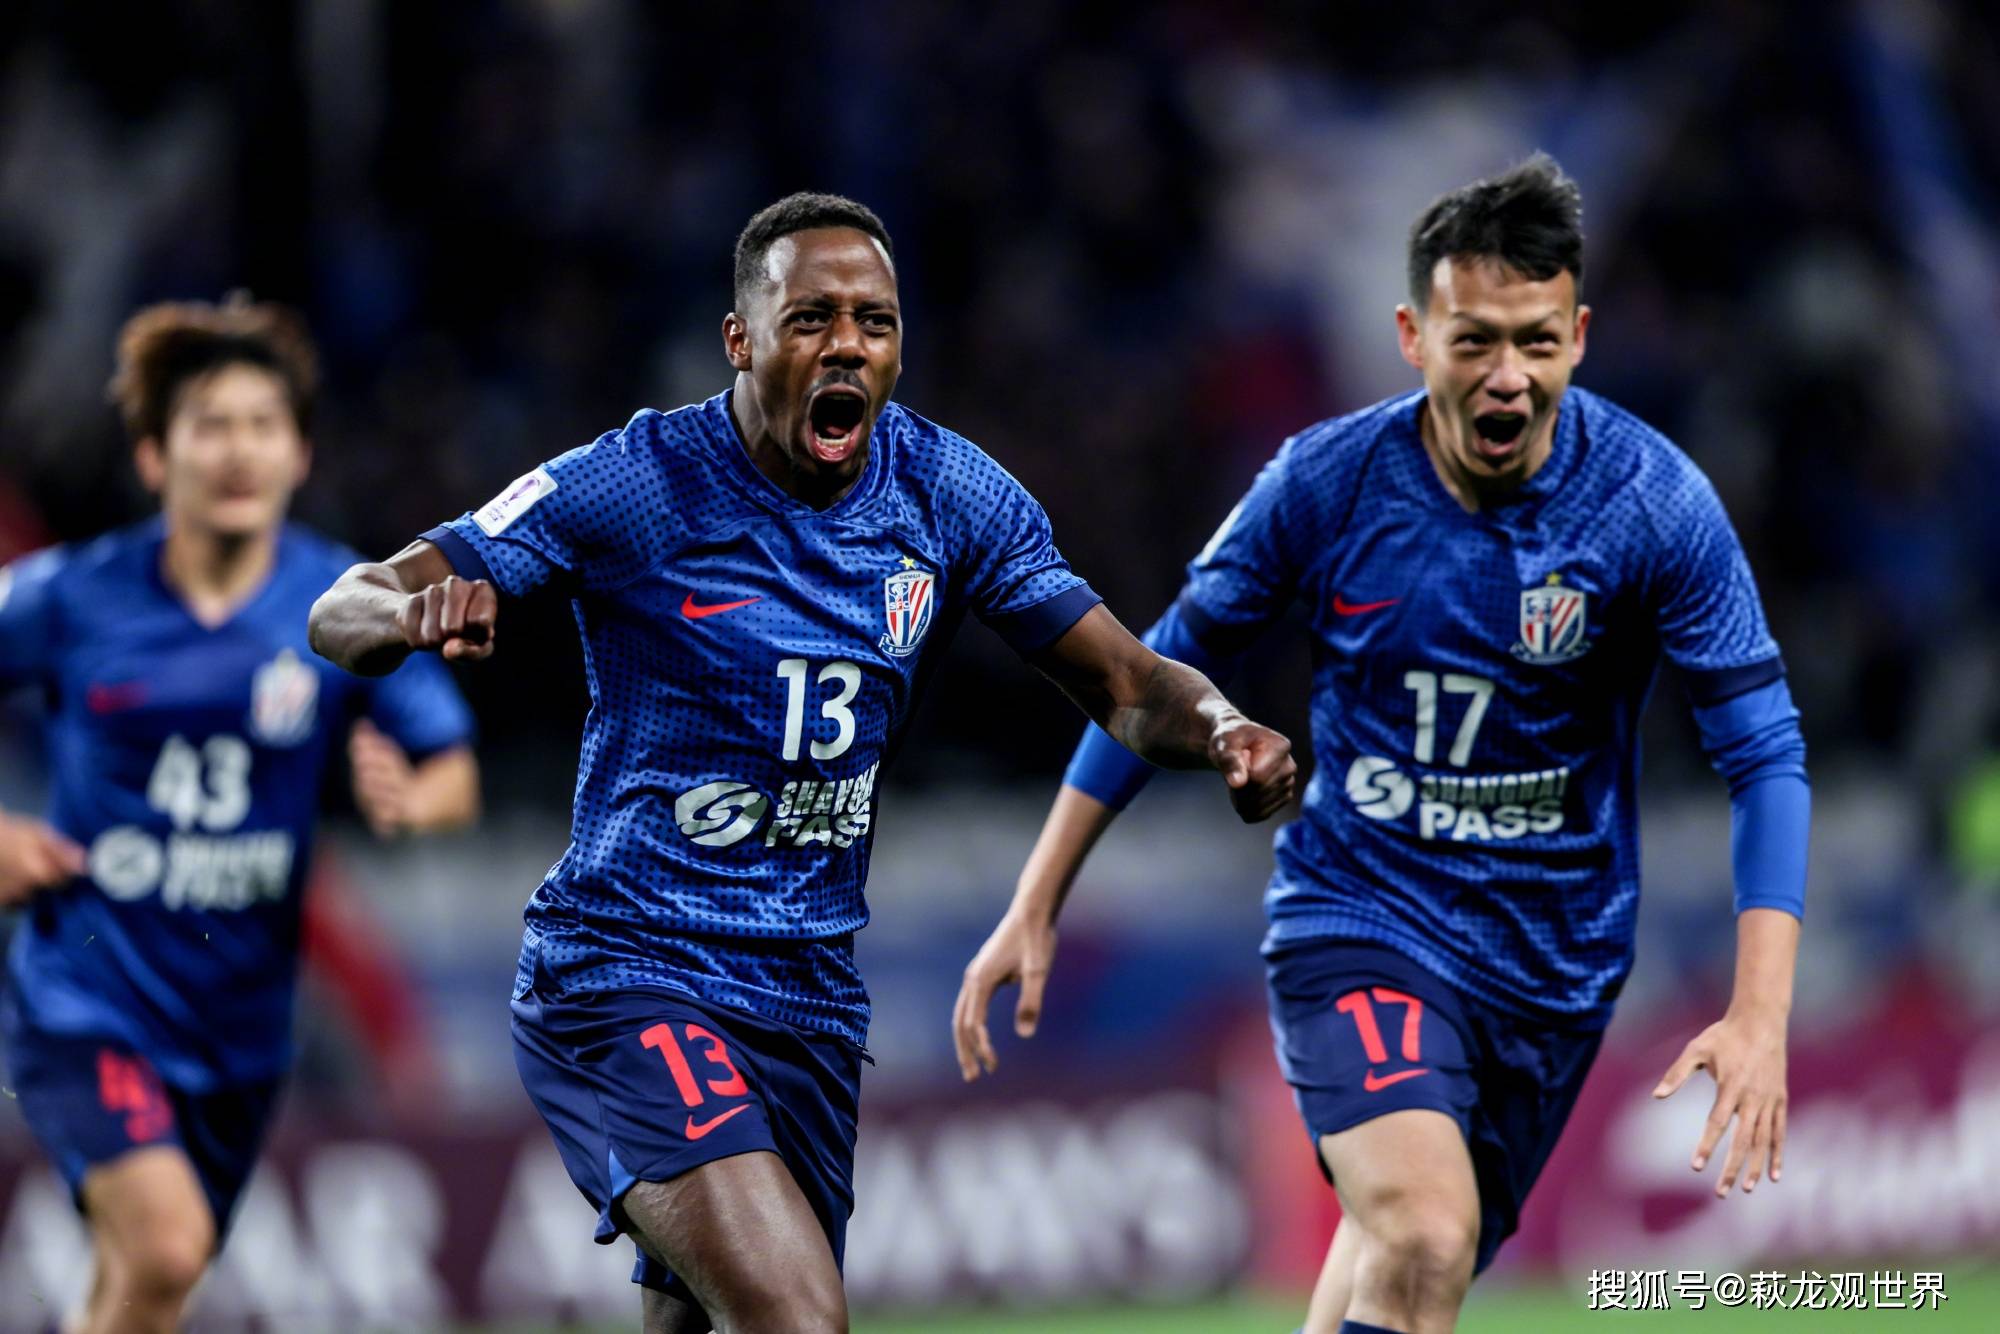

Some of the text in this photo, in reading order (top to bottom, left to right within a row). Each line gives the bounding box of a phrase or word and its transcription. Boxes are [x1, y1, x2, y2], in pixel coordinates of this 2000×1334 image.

[776, 658, 862, 761] 13
[1403, 670, 1496, 768] 17
[147, 734, 252, 834] 43
[1418, 799, 1565, 841] PASS
[639, 1022, 749, 1108] 13
[1335, 986, 1423, 1064] 17
